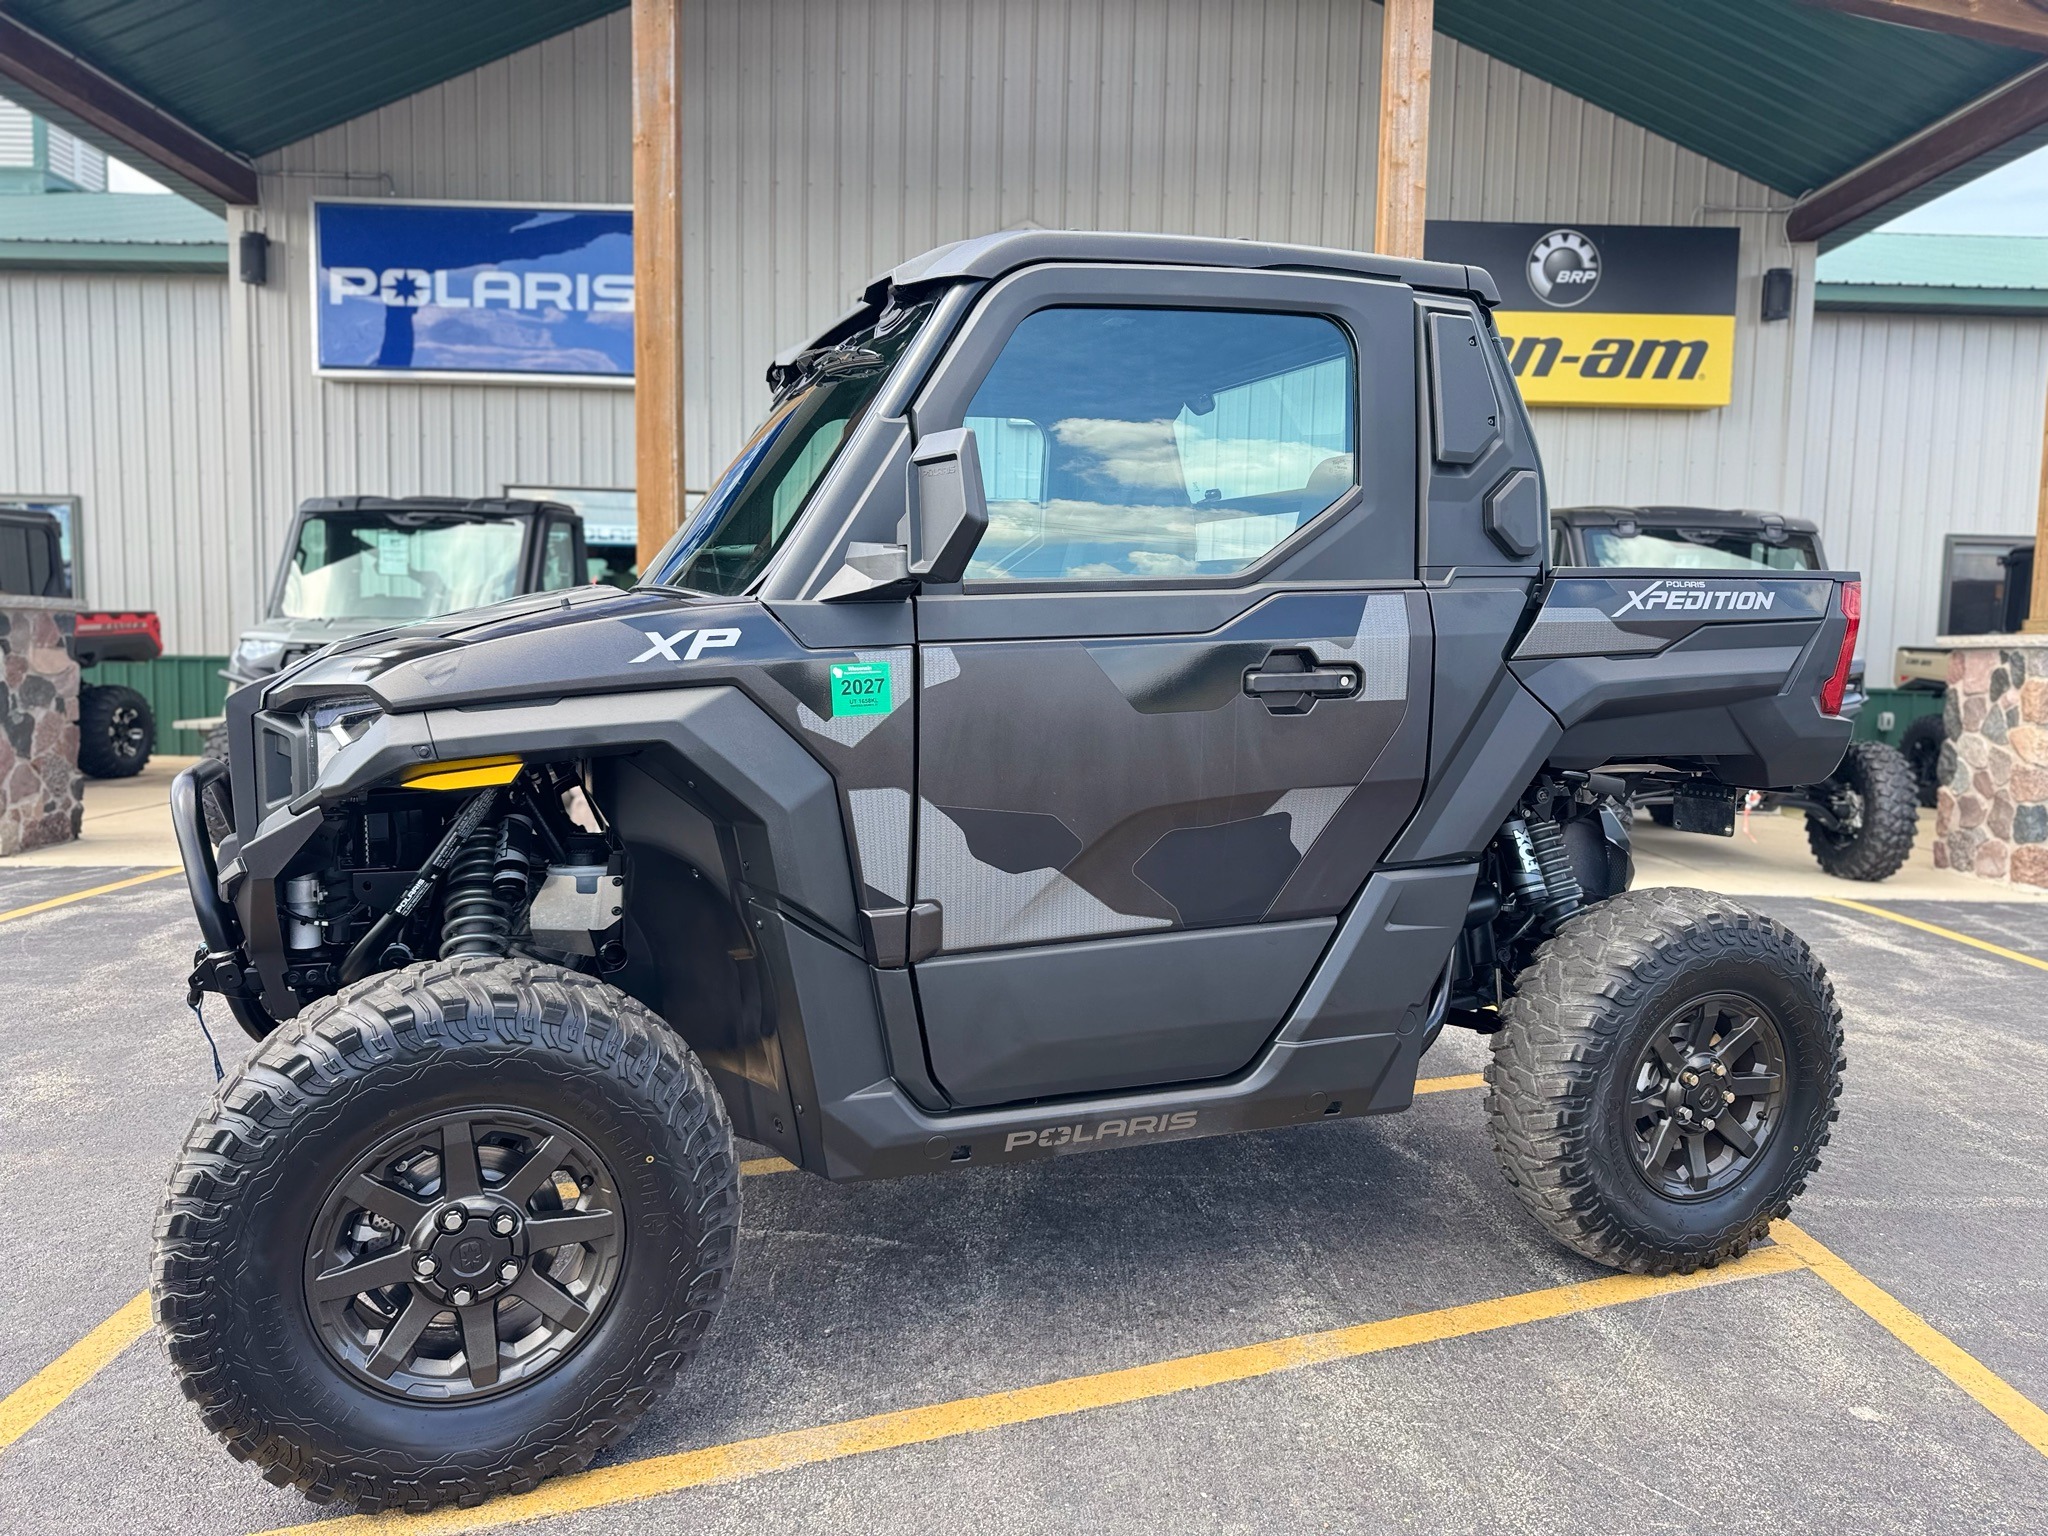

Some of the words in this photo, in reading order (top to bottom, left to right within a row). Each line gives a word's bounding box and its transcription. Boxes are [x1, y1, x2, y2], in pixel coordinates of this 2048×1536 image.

[329, 267, 634, 312] POLARIS
[1556, 270, 1597, 284] BRP
[1500, 337, 1709, 380] n-am
[922, 466, 956, 478] POLARIS
[1611, 580, 1775, 617] XPEDITION
[627, 627, 742, 664] XP
[841, 678, 885, 696] 2027
[395, 878, 425, 914] POLARIS
[1004, 1110, 1199, 1152] POLARIS
